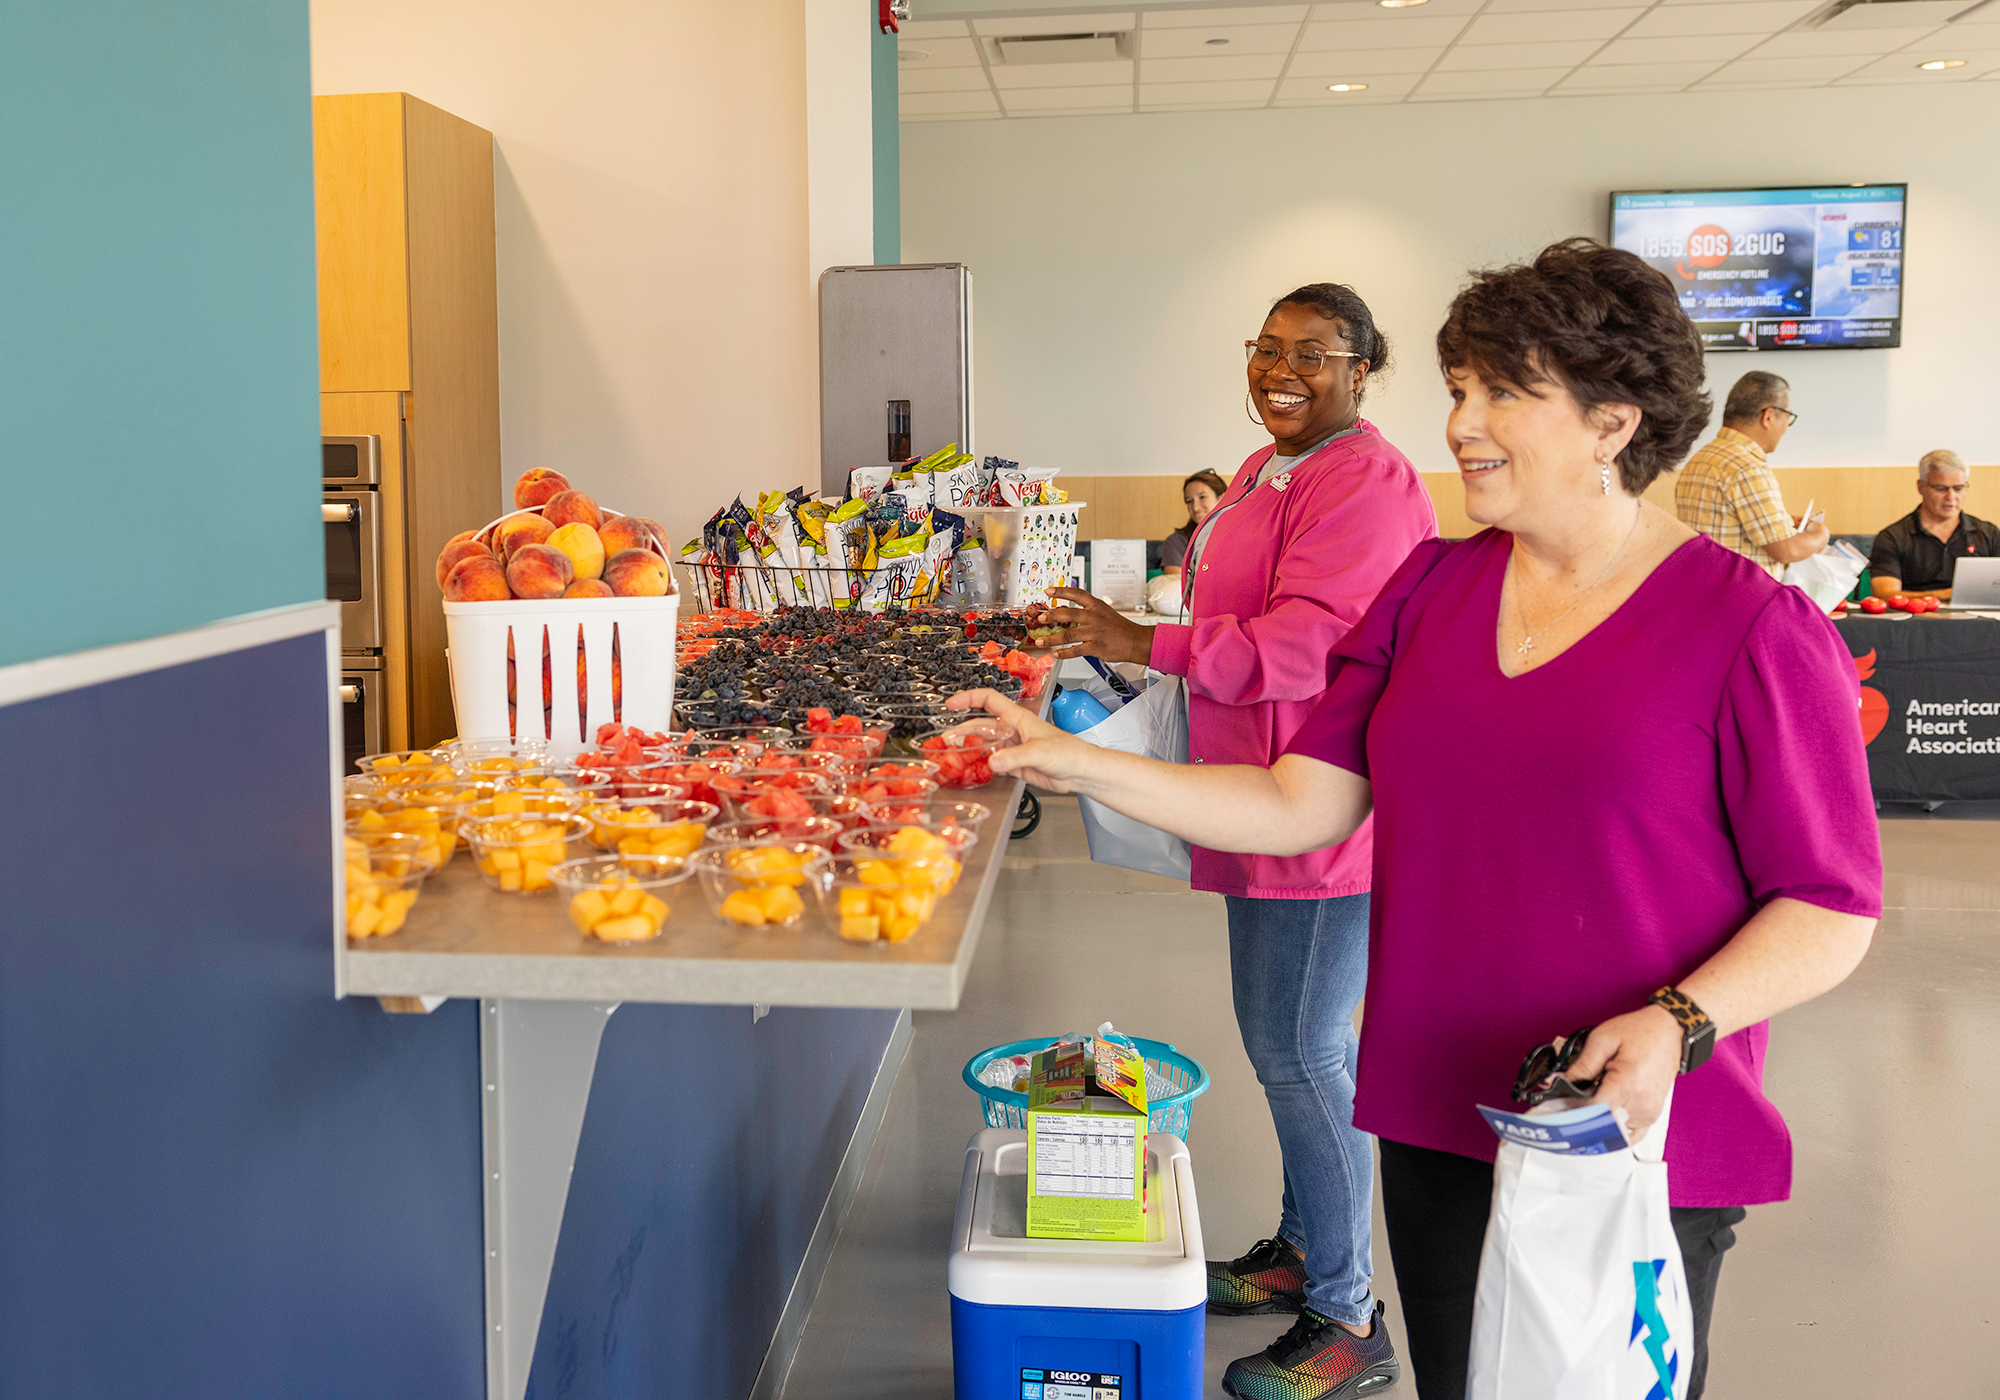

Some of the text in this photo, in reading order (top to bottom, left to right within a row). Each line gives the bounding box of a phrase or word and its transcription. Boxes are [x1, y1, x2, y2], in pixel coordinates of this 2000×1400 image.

[1880, 229, 1901, 248] 81
[1697, 269, 1769, 280] EMERGENCY HOTLINE
[1906, 718, 1968, 735] Heart
[1050, 1370, 1091, 1382] IGLOO
